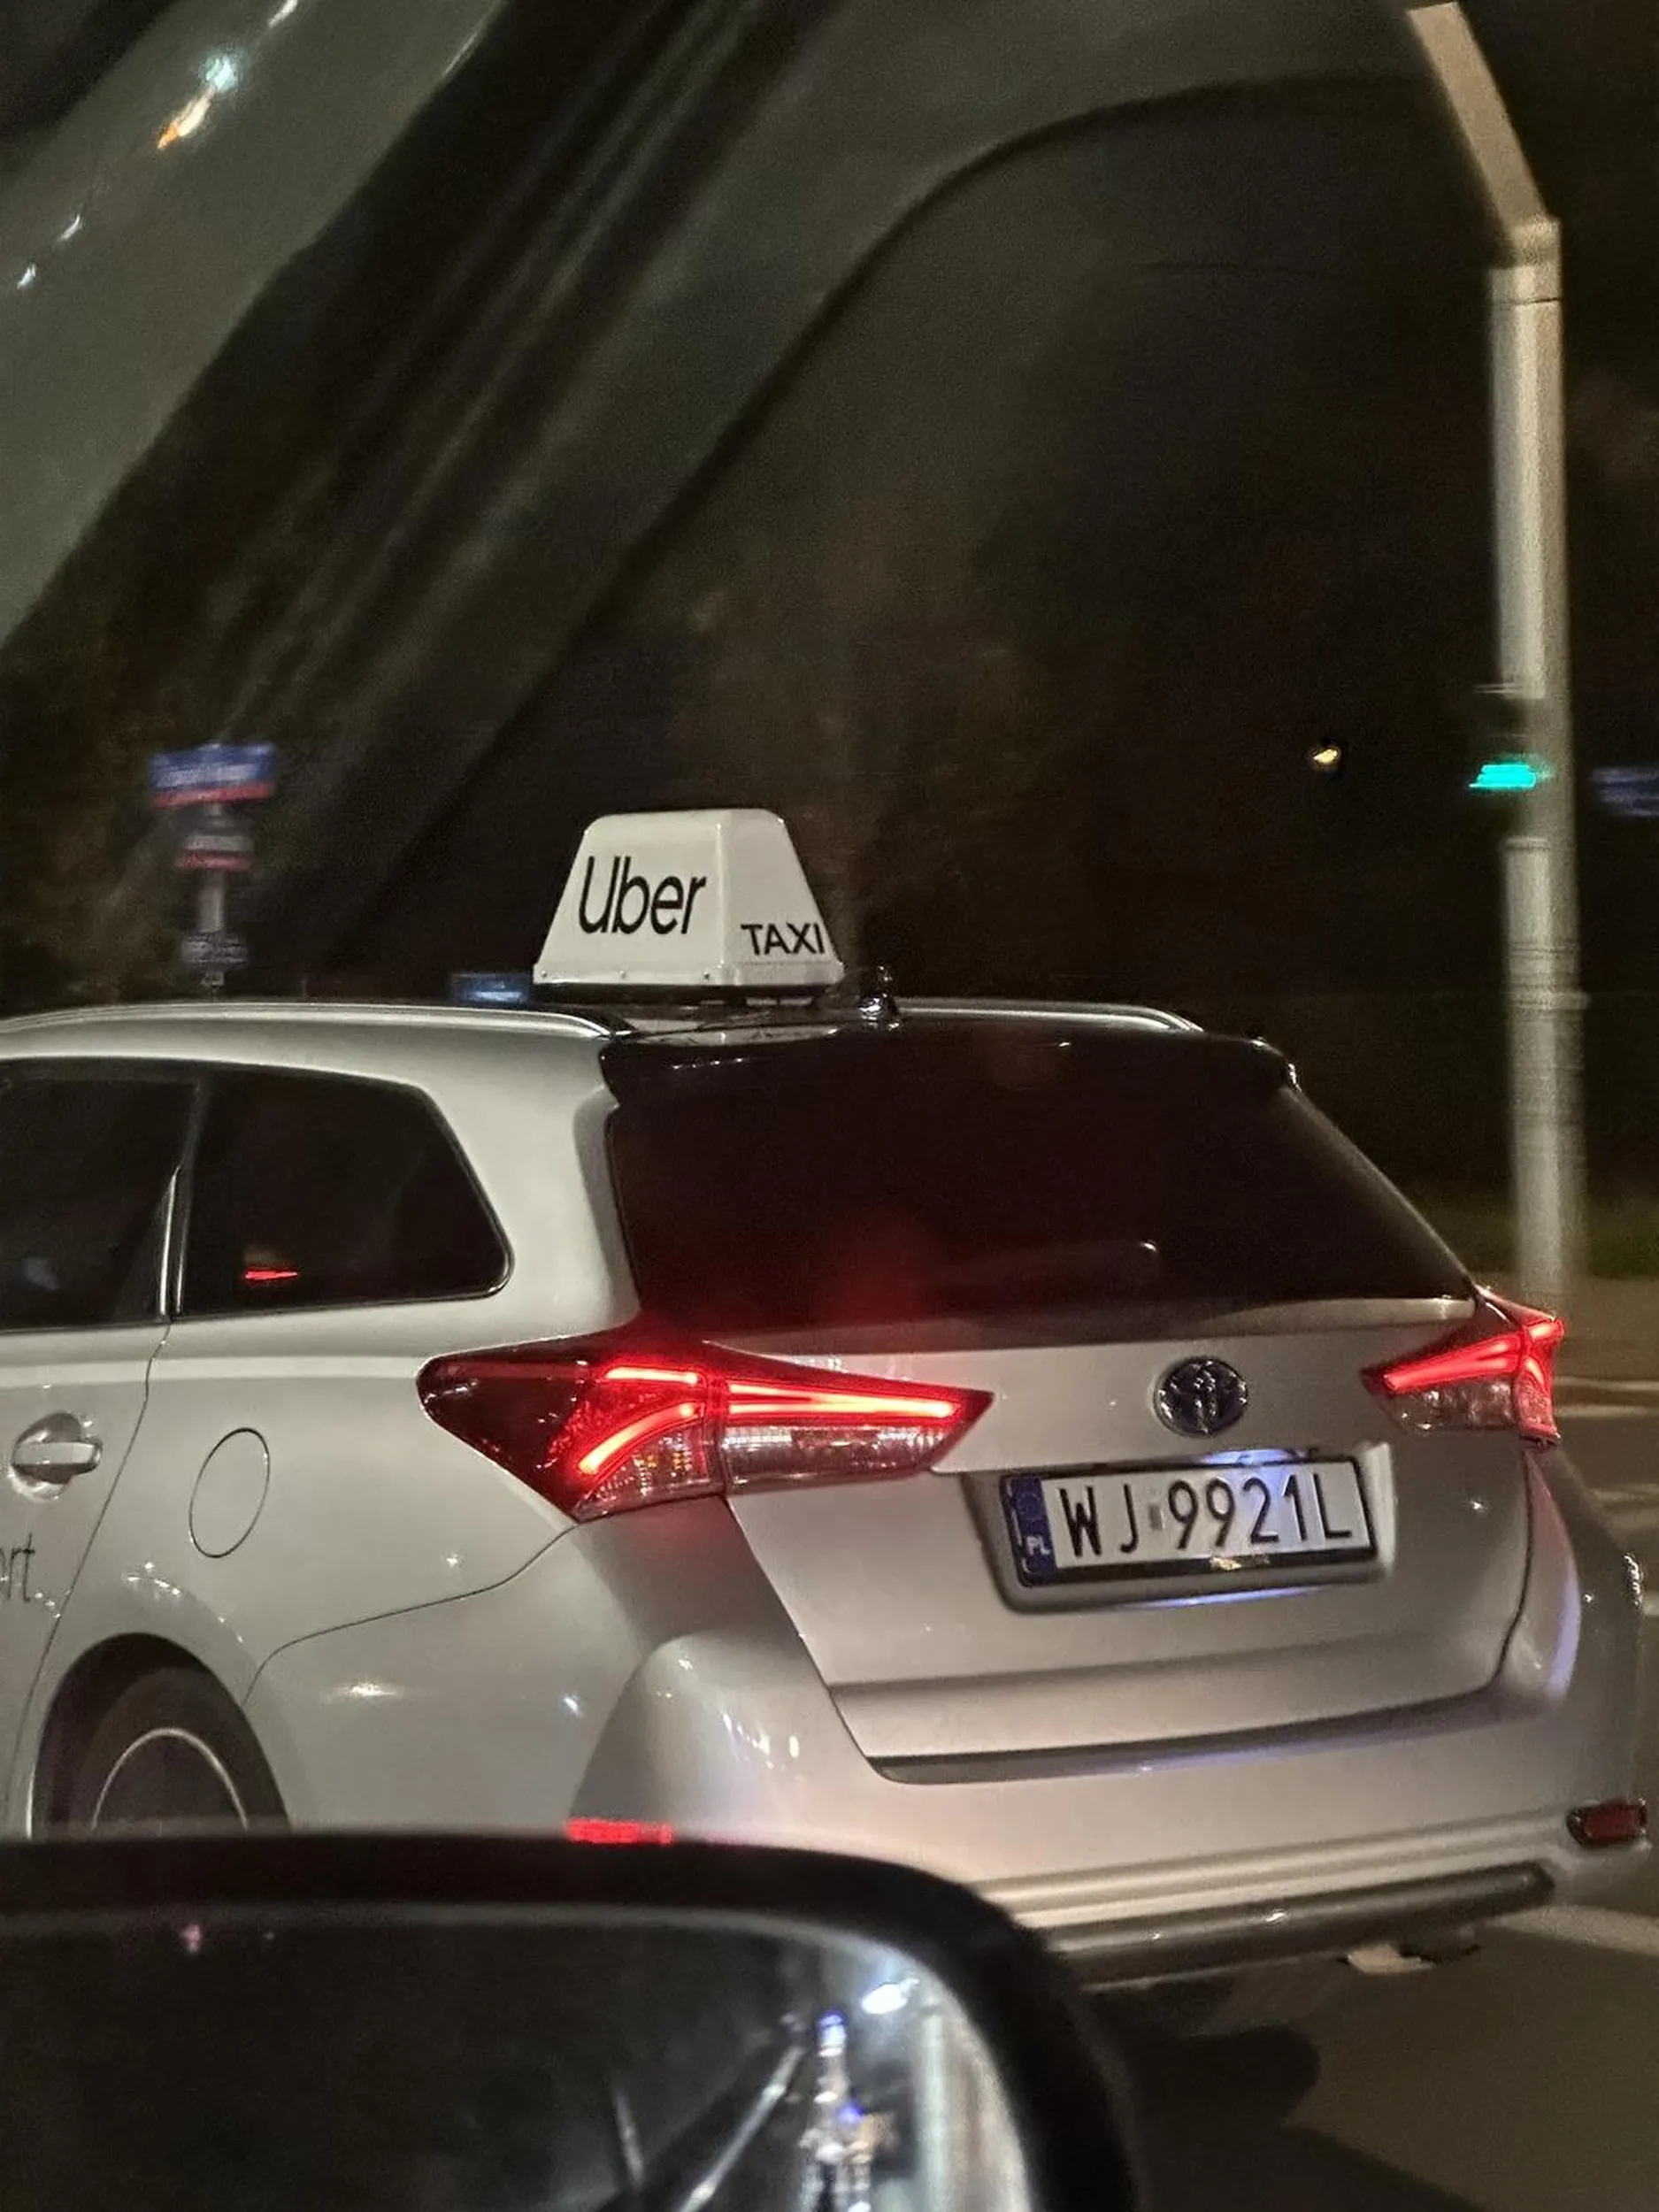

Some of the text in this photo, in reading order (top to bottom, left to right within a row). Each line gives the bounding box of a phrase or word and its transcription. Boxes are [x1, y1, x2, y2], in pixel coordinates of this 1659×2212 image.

[579, 856, 707, 934] Uber
[741, 922, 826, 956] TAXI
[1026, 1535, 1051, 1556] PL
